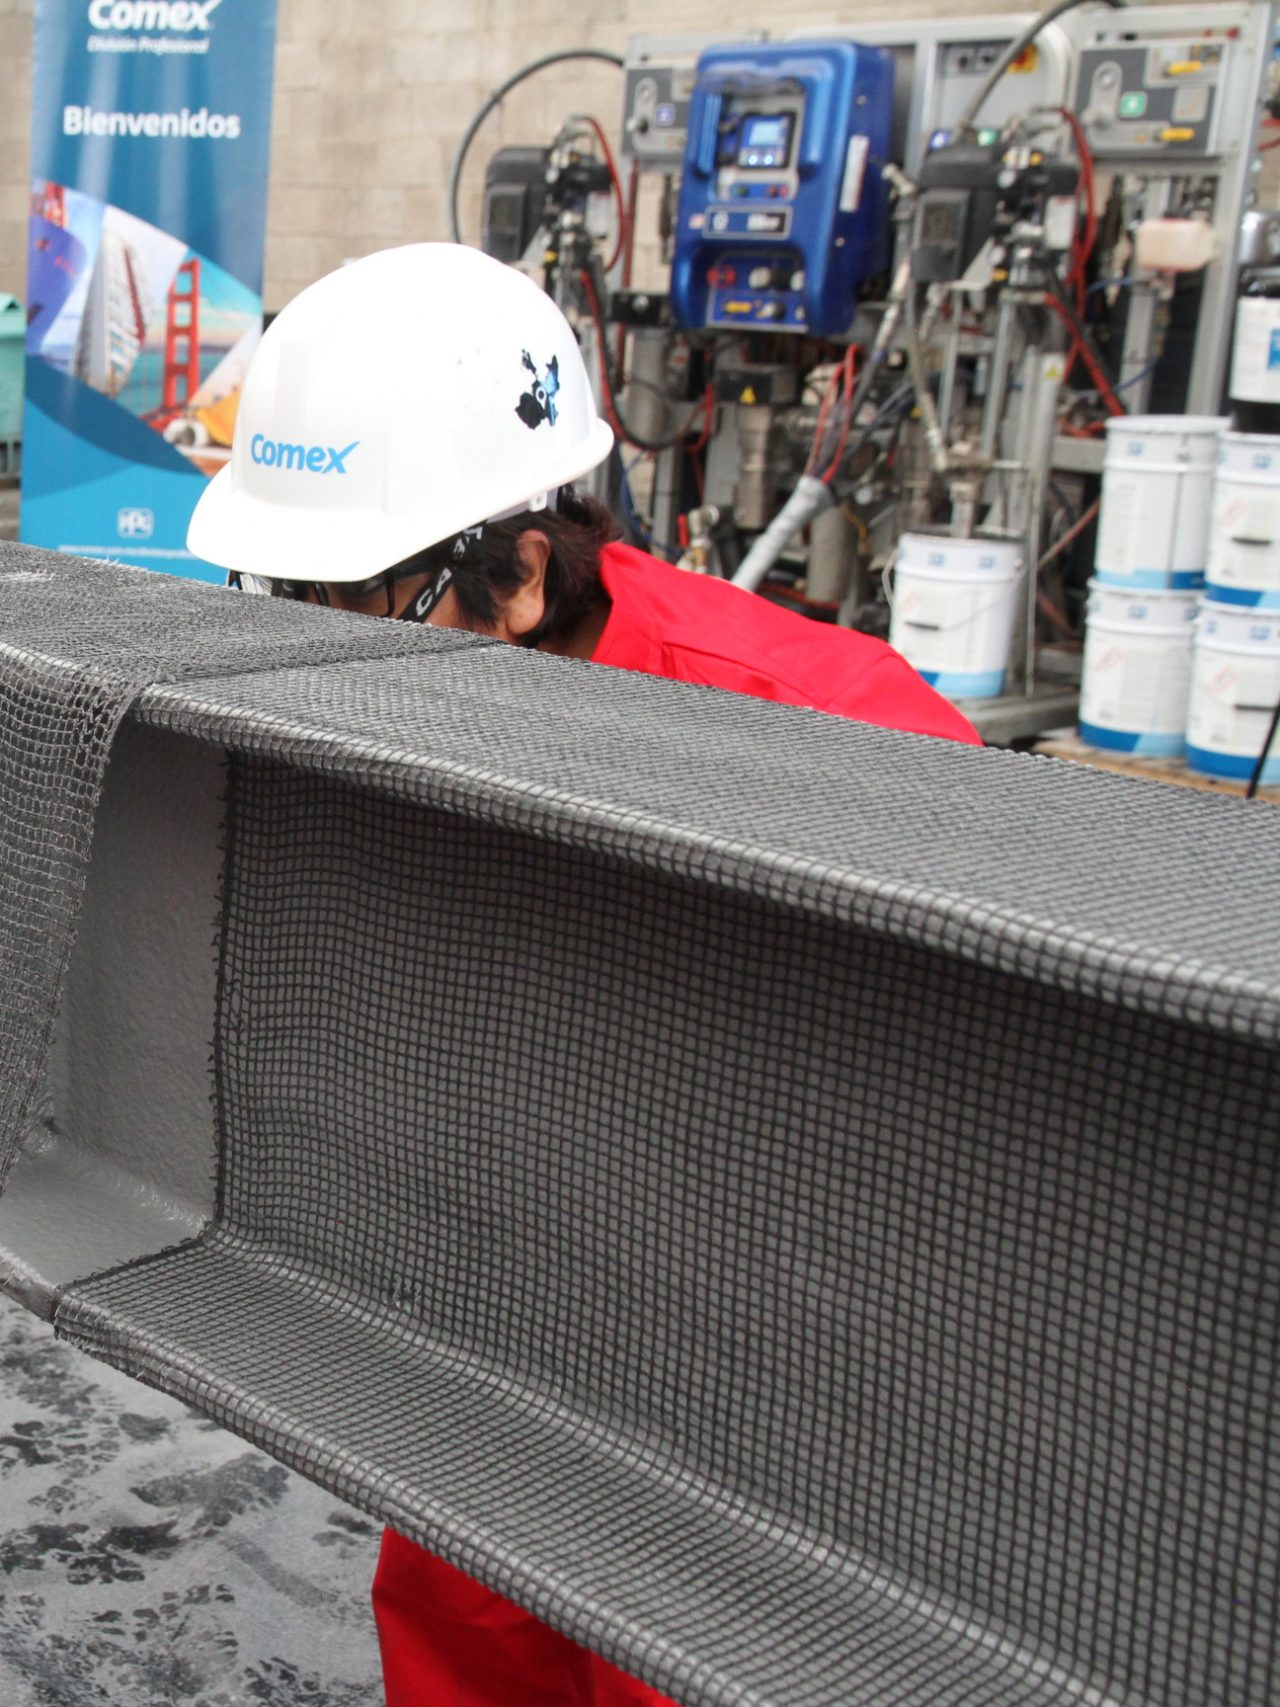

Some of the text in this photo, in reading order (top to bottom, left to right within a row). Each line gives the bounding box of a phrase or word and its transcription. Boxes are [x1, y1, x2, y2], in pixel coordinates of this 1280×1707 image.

[87, 0, 220, 31] Comex
[63, 106, 241, 138] Bienvenidos
[251, 433, 359, 475] Comex
